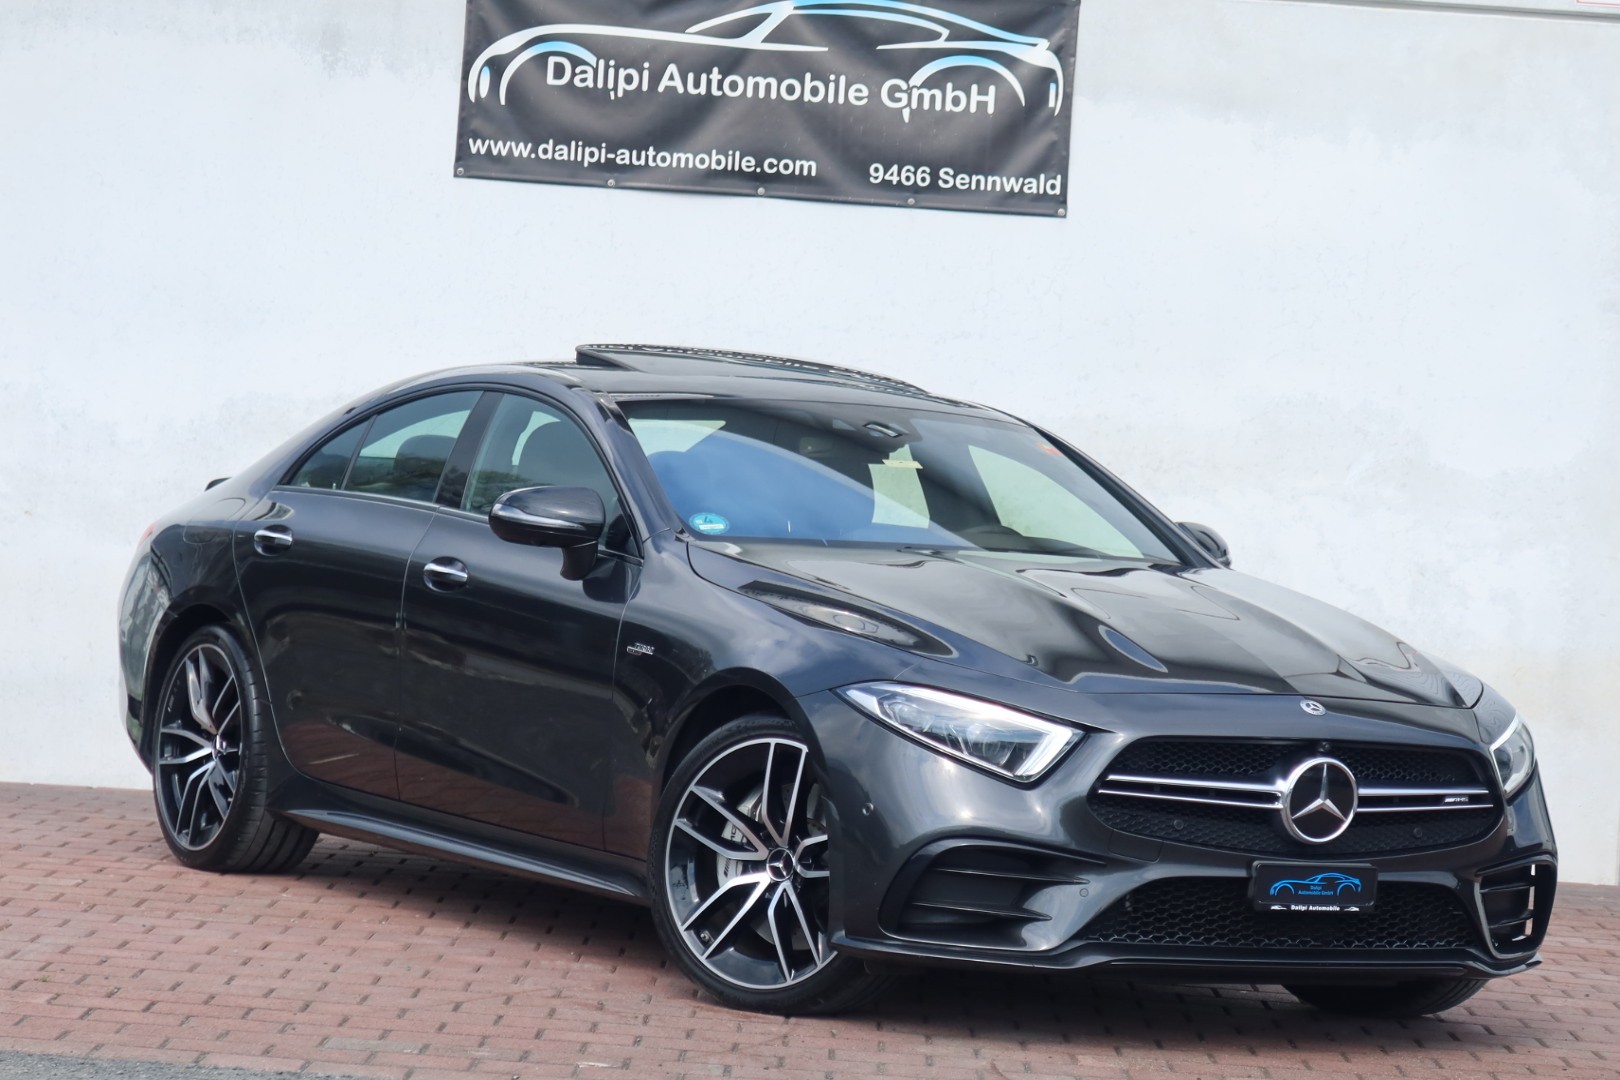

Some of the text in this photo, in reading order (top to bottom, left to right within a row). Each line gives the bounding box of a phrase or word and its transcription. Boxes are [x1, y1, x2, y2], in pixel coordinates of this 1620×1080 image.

[546, 55, 996, 115] Dalipi Automobile GmbH
[468, 138, 817, 177] www.dalipi-automobile.com
[869, 163, 1062, 195] 9466 Sennwald
